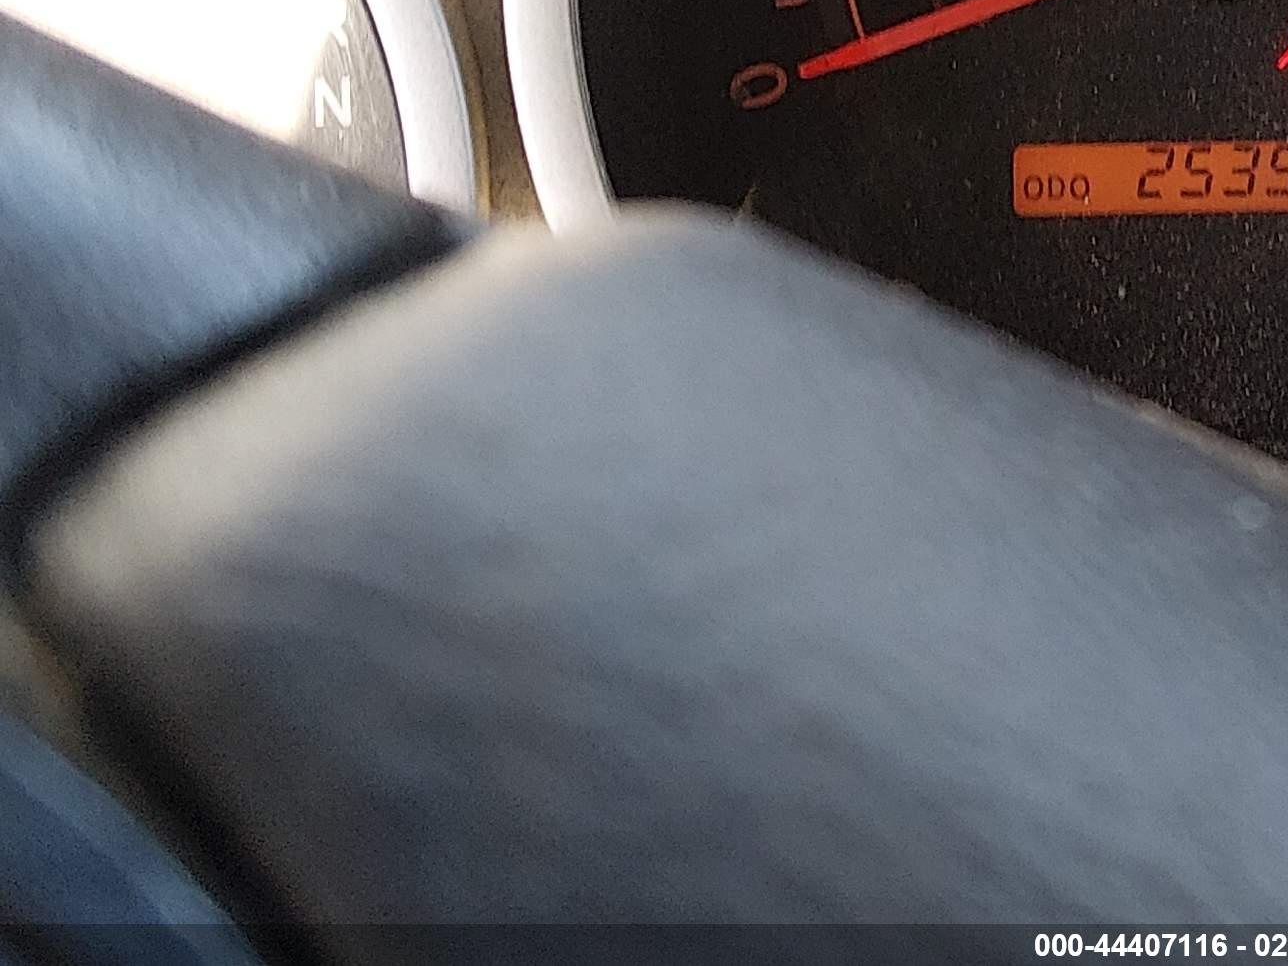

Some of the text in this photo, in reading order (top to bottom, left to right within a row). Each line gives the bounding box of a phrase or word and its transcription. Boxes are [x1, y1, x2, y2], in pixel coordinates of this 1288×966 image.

[313, 74, 353, 129] N
[728, 62, 789, 110] 0
[1022, 173, 1092, 203] ODO
